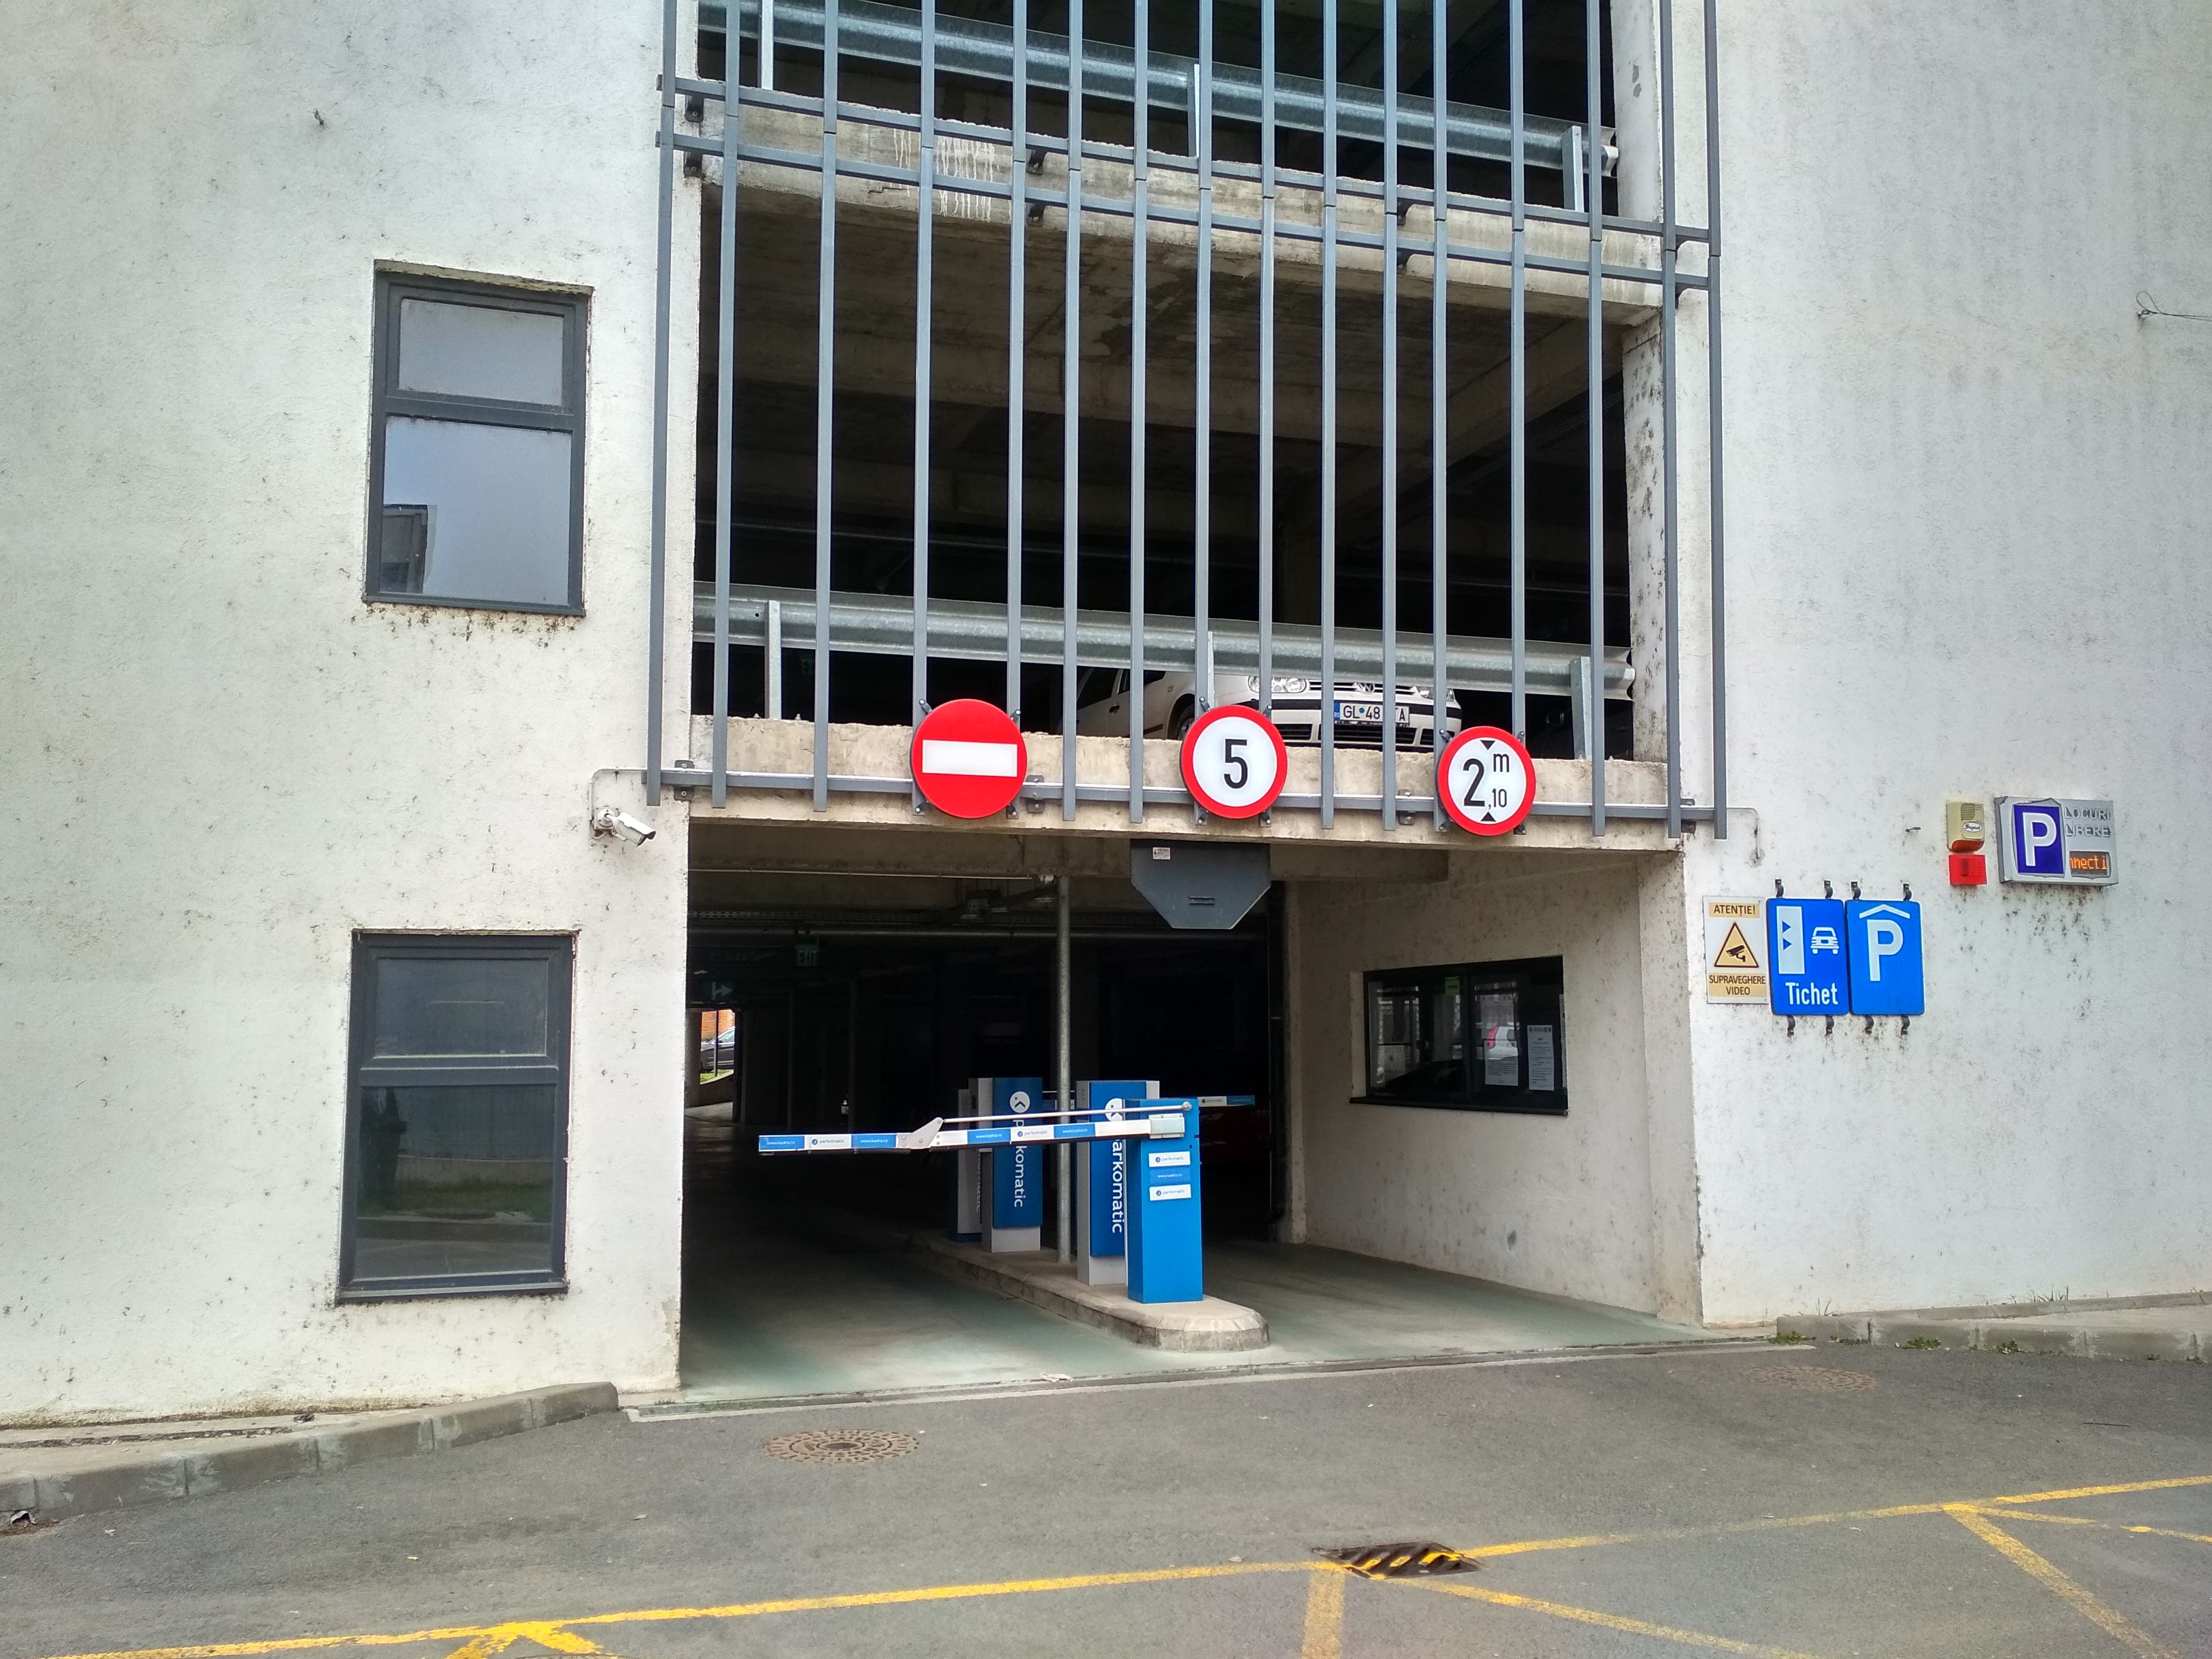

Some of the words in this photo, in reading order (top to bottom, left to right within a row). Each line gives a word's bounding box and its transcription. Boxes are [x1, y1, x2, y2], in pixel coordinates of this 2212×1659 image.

[1343, 705, 1360, 718] GL
[1365, 706, 1380, 719] 48
[1224, 739, 1248, 789] 5
[1493, 753, 1510, 773] m
[2065, 807, 2110, 820] LOCURI
[2022, 812, 2057, 867] P
[2065, 824, 2110, 837] LIBERE
[797, 951, 817, 966] EXIT
[1866, 919, 1904, 982] P
[1709, 975, 1766, 985] SUPRAVEGHERE
[1726, 986, 1750, 995] VIDEO
[1785, 982, 1839, 1005] Tichet
[1013, 1119, 1028, 1208] pkomatic
[1112, 1139, 1125, 1233] arkomatic
